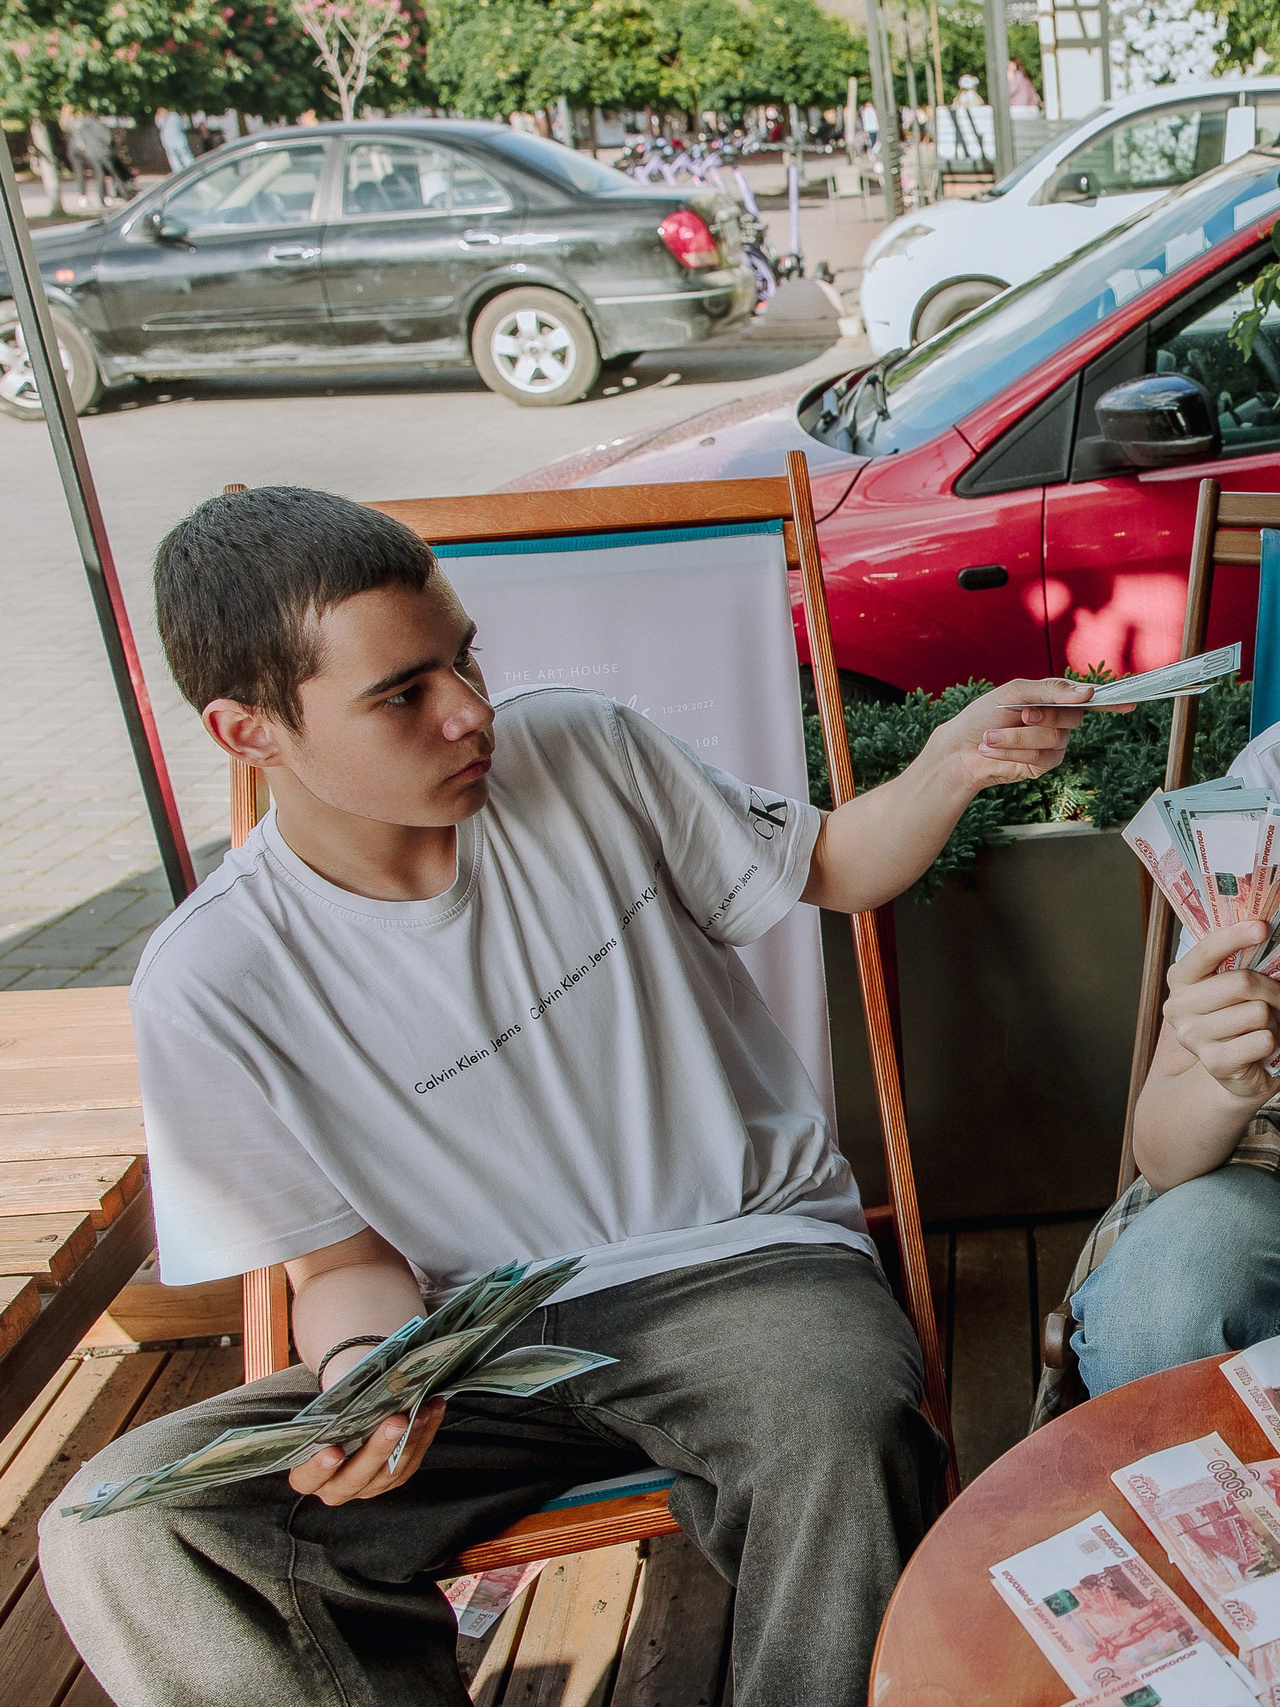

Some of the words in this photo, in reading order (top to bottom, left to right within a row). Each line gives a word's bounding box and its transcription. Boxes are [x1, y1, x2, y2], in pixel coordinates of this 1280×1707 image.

[503, 671, 531, 682] THE
[537, 668, 564, 681] ART
[571, 663, 620, 677] HOUSE
[662, 700, 715, 714] 10.29.2022
[695, 735, 719, 748] 108
[1196, 829, 1210, 874] ПРИКОЛОВ
[1262, 824, 1275, 866] ПРИКОЛОВ
[718, 885, 742, 911] Klein
[739, 864, 759, 886] Jeans
[1258, 867, 1267, 892] БАНКА
[1252, 891, 1263, 915] БИЛЕТ
[529, 988, 563, 1020] Calvin
[559, 964, 590, 992] Klein
[588, 937, 618, 967] Jeans
[414, 1067, 457, 1094] Calvin
[455, 1048, 490, 1072] Klein
[490, 1024, 522, 1053] Jeans
[1233, 1366, 1254, 1386] ПЯТЬ
[1248, 1385, 1271, 1412] ТЫСЯЧ
[1129, 1475, 1157, 1502] 5000
[1207, 1459, 1253, 1502] 5000
[1001, 1570, 1036, 1606] ПРИКОЛОВ
[1224, 1600, 1252, 1631] 5000
[1141, 1650, 1198, 1680] ПРИКОЛОВ
